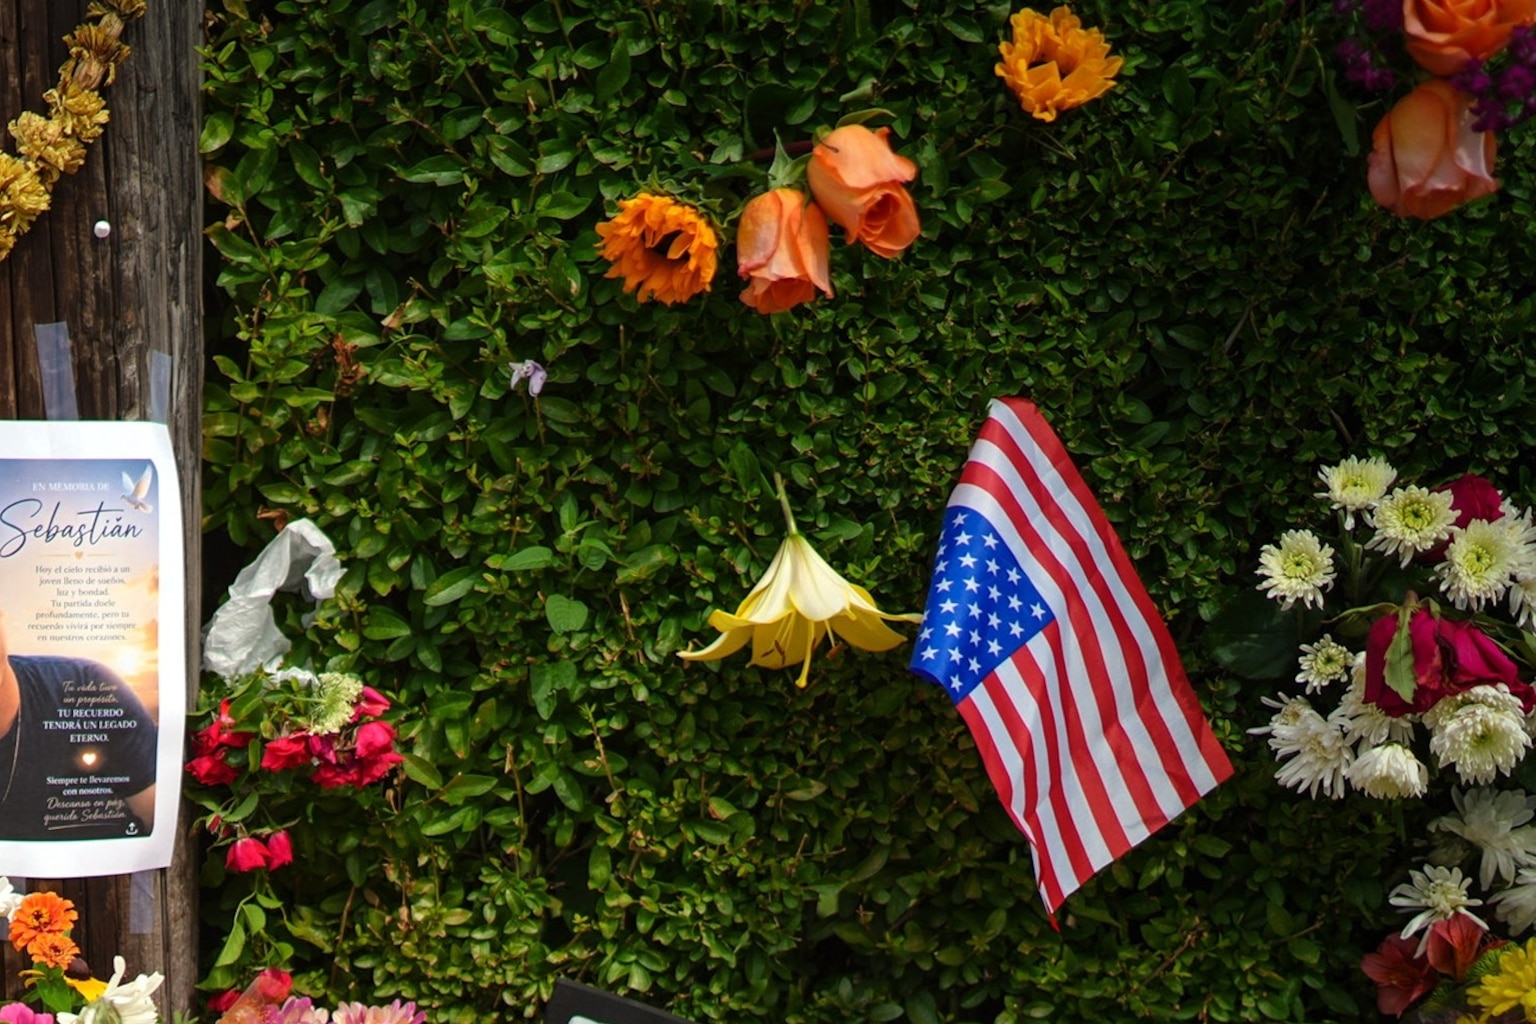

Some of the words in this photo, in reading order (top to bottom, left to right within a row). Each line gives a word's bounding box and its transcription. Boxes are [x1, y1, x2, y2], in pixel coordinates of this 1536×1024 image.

[32, 482, 46, 492] EN
[48, 482, 95, 492] MEMORIA
[97, 482, 110, 492] DE
[0, 499, 143, 558] Sebastián
[35, 566, 52, 575] Hoy
[85, 565, 111, 573] recibió
[39, 578, 61, 587] joven
[64, 577, 84, 585] lleno
[63, 600, 92, 609] partida
[94, 599, 116, 607] duele
[102, 612, 119, 620] pero
[28, 622, 64, 630] recuerdo
[90, 623, 104, 631] por
[106, 622, 136, 631] siempre
[62, 680, 73, 692] Tu
[57, 709, 71, 718] TU
[72, 708, 124, 718] RECUERDO
[43, 719, 82, 730] TENDRÁ
[84, 721, 97, 729] UN
[99, 720, 137, 729] LEGADO
[70, 734, 109, 743] ETERNO.
[46, 776, 78, 786] Siempre
[80, 776, 88, 784] te
[89, 775, 130, 784] llevaremos
[79, 787, 114, 795] nosotros.
